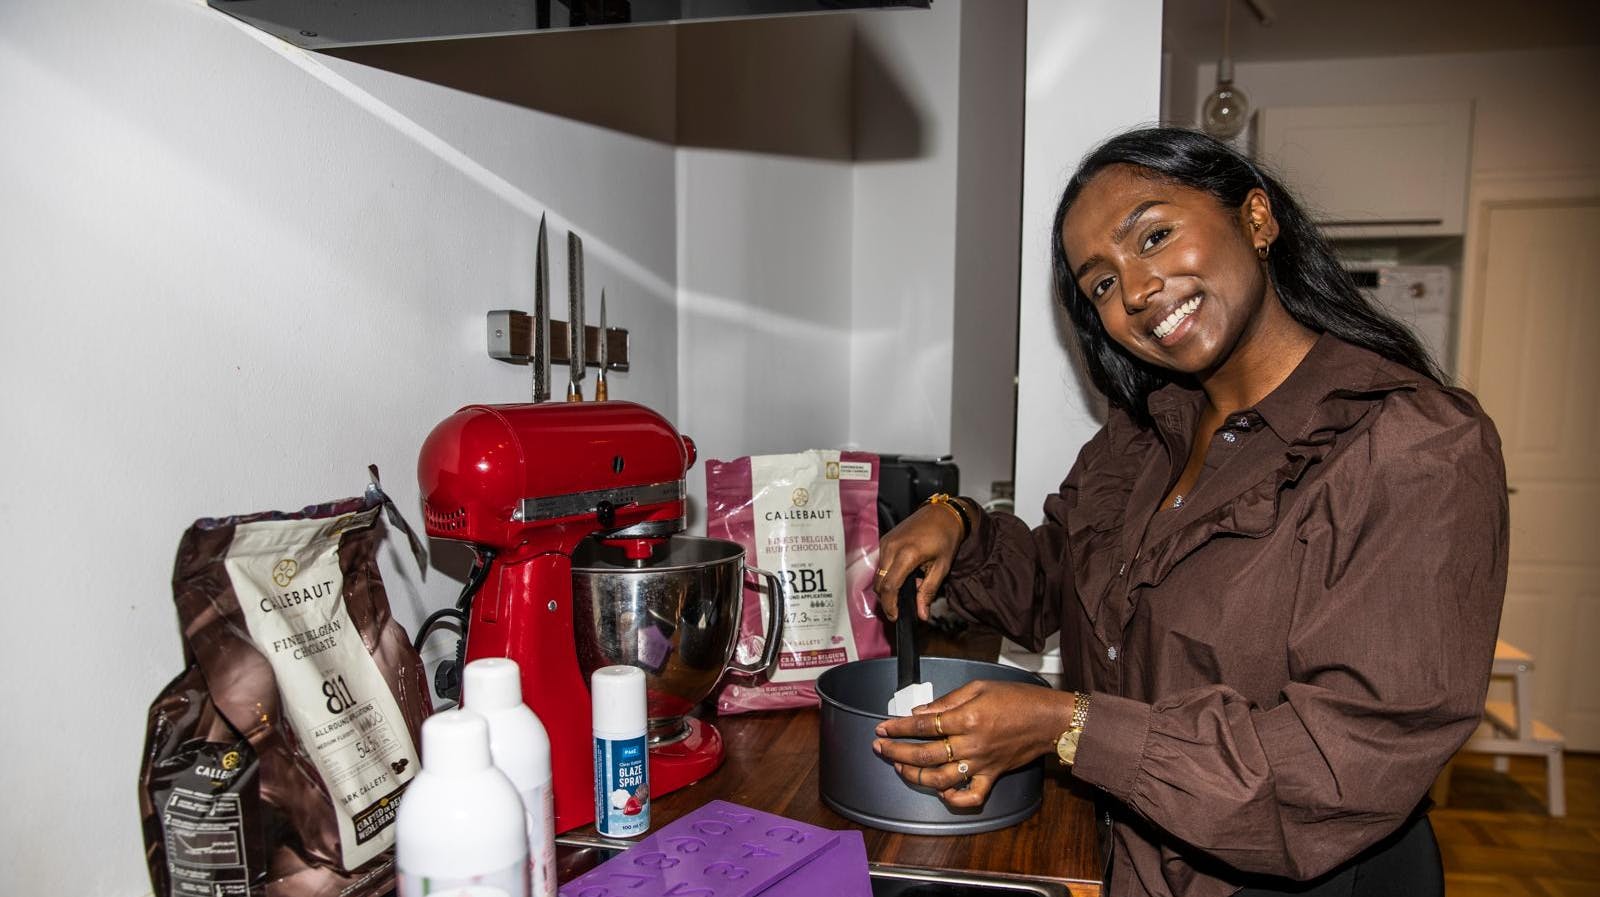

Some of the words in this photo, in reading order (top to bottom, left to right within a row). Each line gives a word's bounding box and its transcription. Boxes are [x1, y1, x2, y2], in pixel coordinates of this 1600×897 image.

[765, 510, 832, 520] CALLEBAUT
[801, 535, 835, 543] BELGIAN
[792, 543, 838, 551] CHOCOLATE
[778, 568, 827, 593] RB1
[780, 655, 811, 663] CRATED
[322, 675, 357, 714] 811
[619, 764, 642, 778] GLAZE
[619, 774, 642, 788] SPRAY
